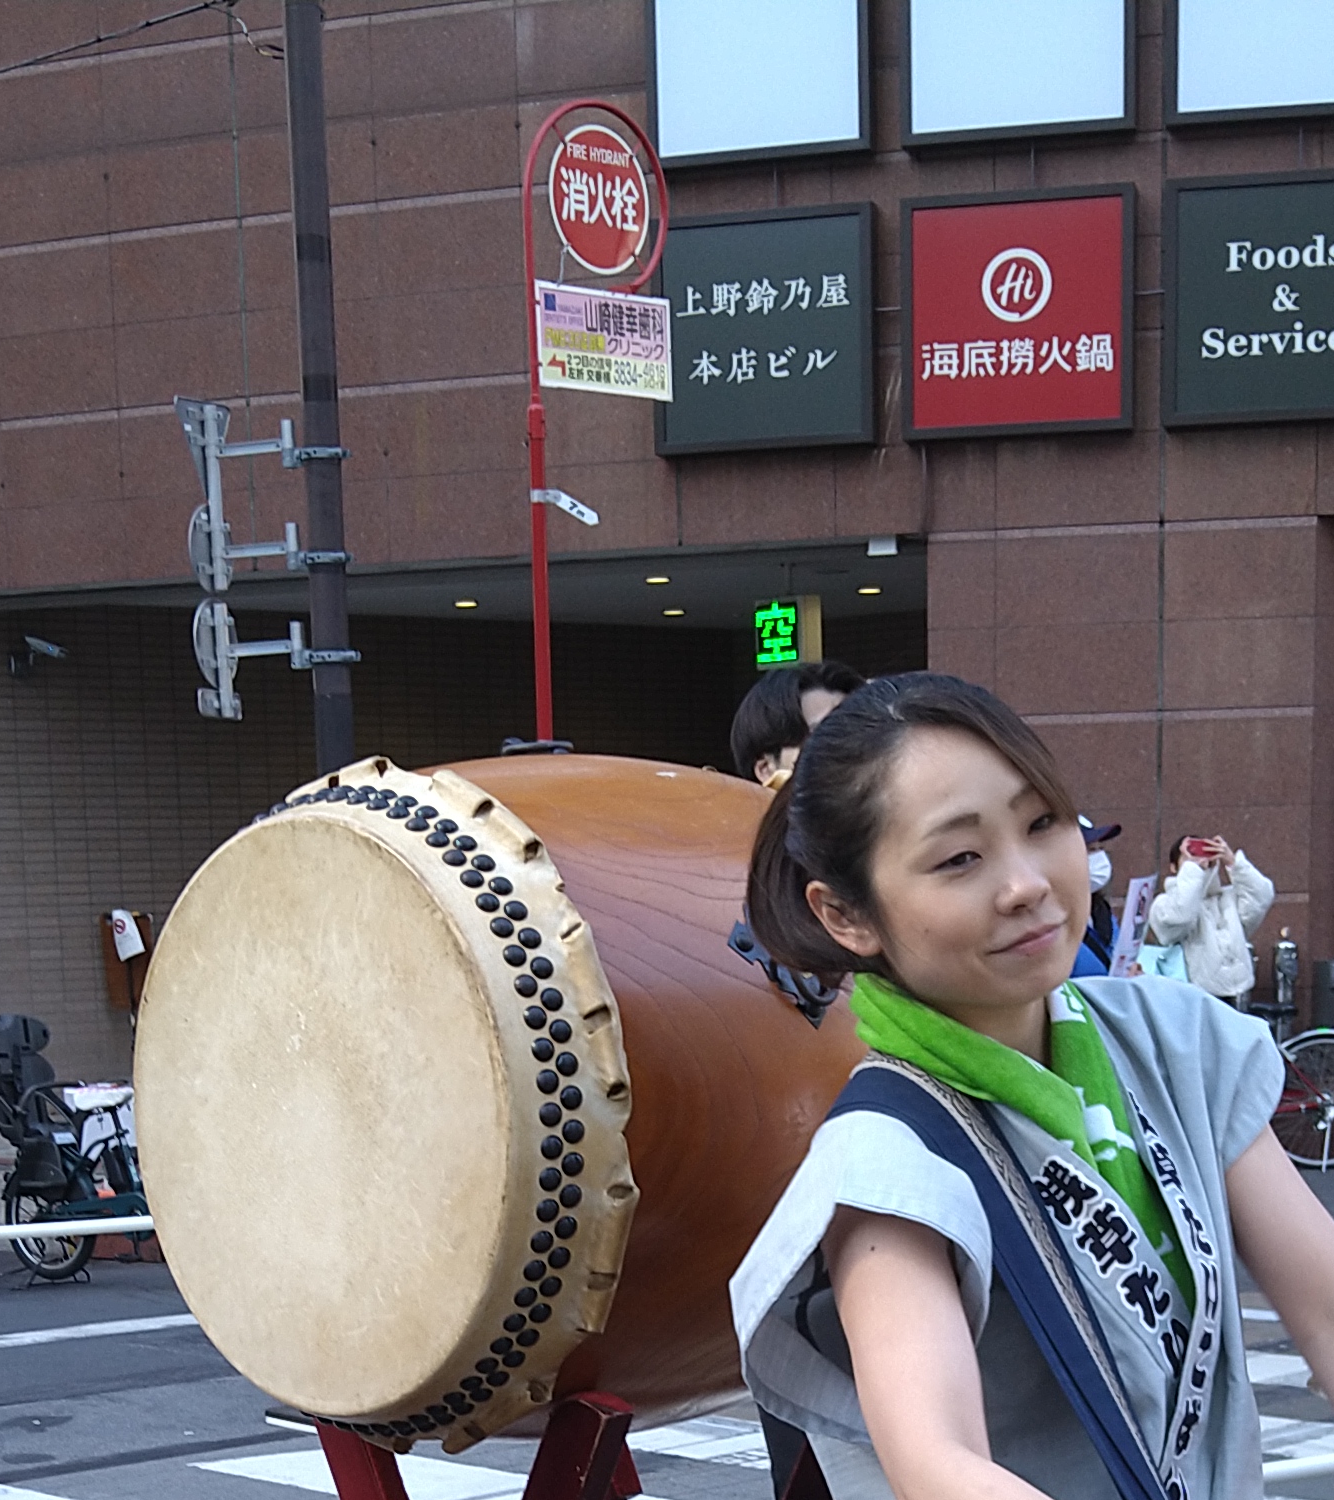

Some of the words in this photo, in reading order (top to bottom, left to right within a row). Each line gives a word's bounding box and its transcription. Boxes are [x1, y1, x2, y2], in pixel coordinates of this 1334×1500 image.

[567, 142, 588, 161] FIRE
[589, 145, 630, 169] HYDRANT
[560, 166, 640, 232] 消火栓
[675, 273, 851, 318] 上野鈴乃屋
[1272, 283, 1300, 312] &
[607, 338, 665, 361] クリニック
[688, 345, 838, 385] 本店ビル
[920, 333, 1114, 381] 海底撈火鍋
[755, 601, 797, 664] 空
